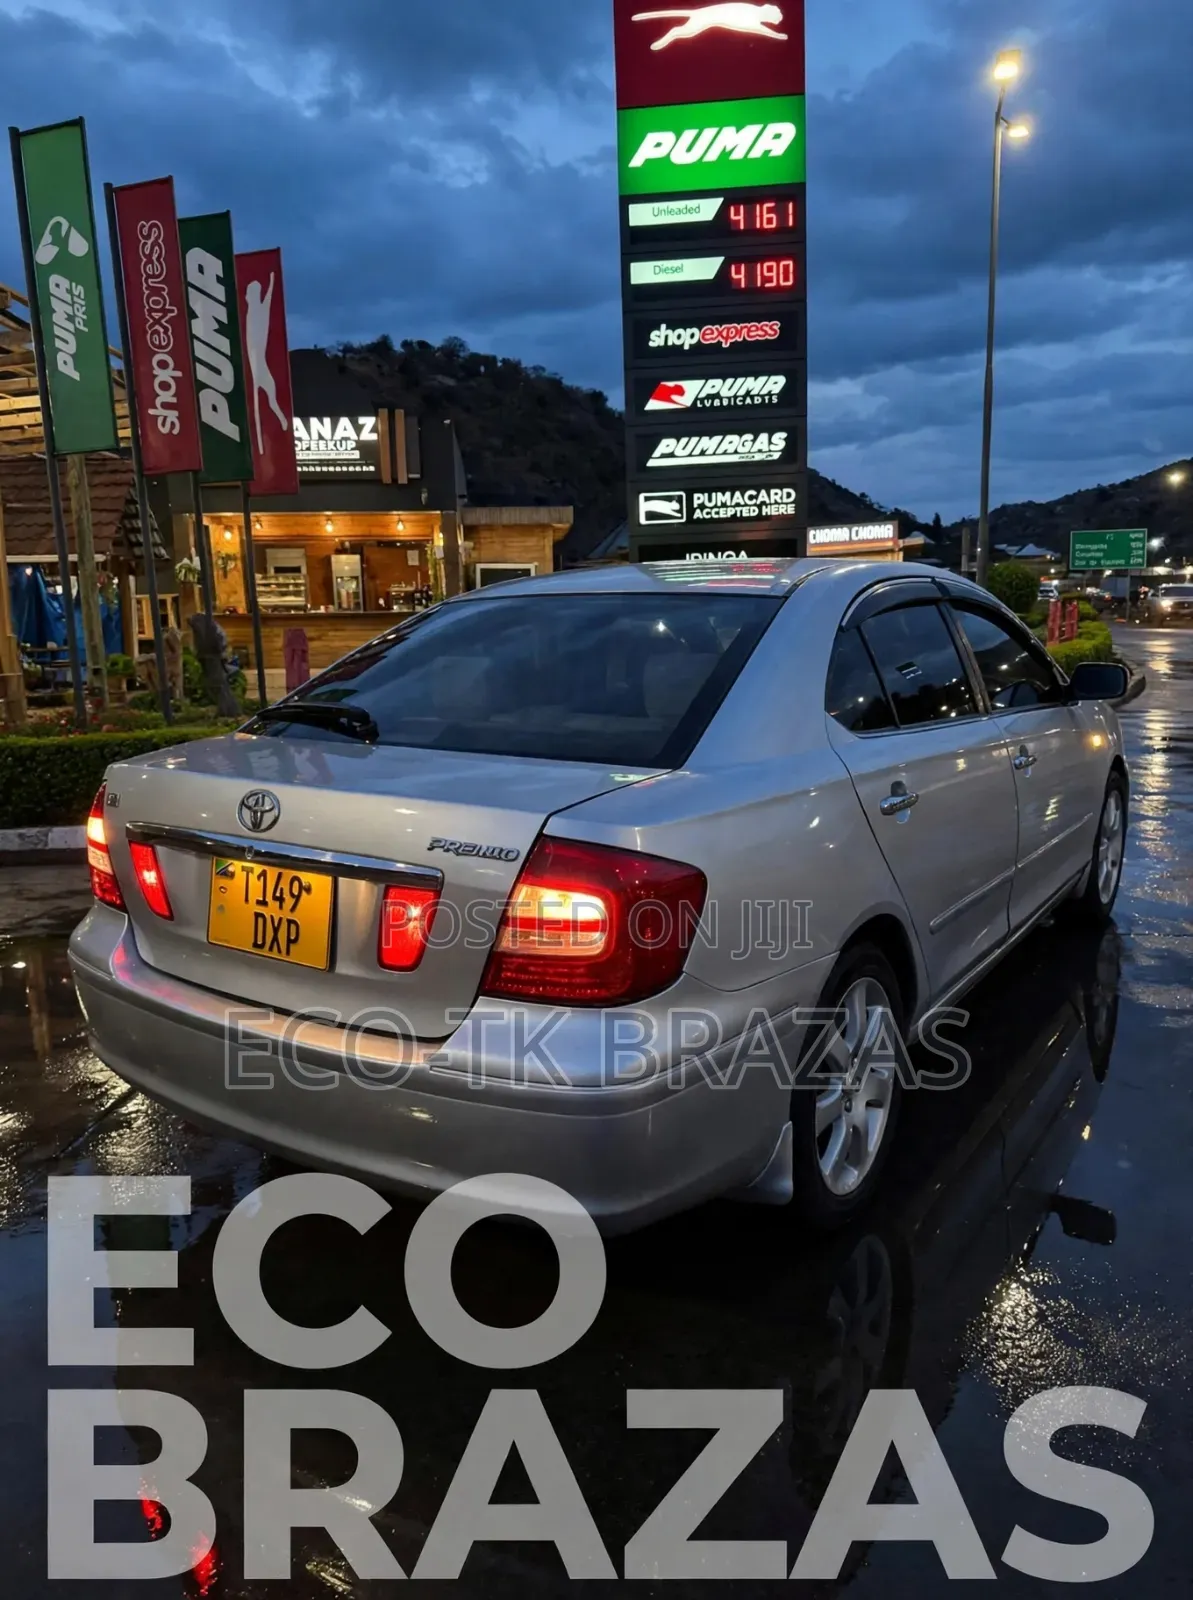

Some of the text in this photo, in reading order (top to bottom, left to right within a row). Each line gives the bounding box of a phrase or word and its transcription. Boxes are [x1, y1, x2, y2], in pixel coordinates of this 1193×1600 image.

[628, 122, 797, 168] PUMA
[652, 201, 793, 231] Unleaded 4161
[653, 260, 794, 289] Diesel 4190
[71, 281, 89, 333] PRIS
[48, 274, 81, 381] PUMA
[186, 247, 240, 443] PUMA
[697, 374, 787, 399] PUMA
[693, 488, 796, 509] PUMACARD
[693, 503, 796, 520] ACCEPTED HERE
[808, 523, 894, 545] CHOMA CHOMA
[241, 865, 303, 914] T149
[252, 911, 300, 957] DXP
